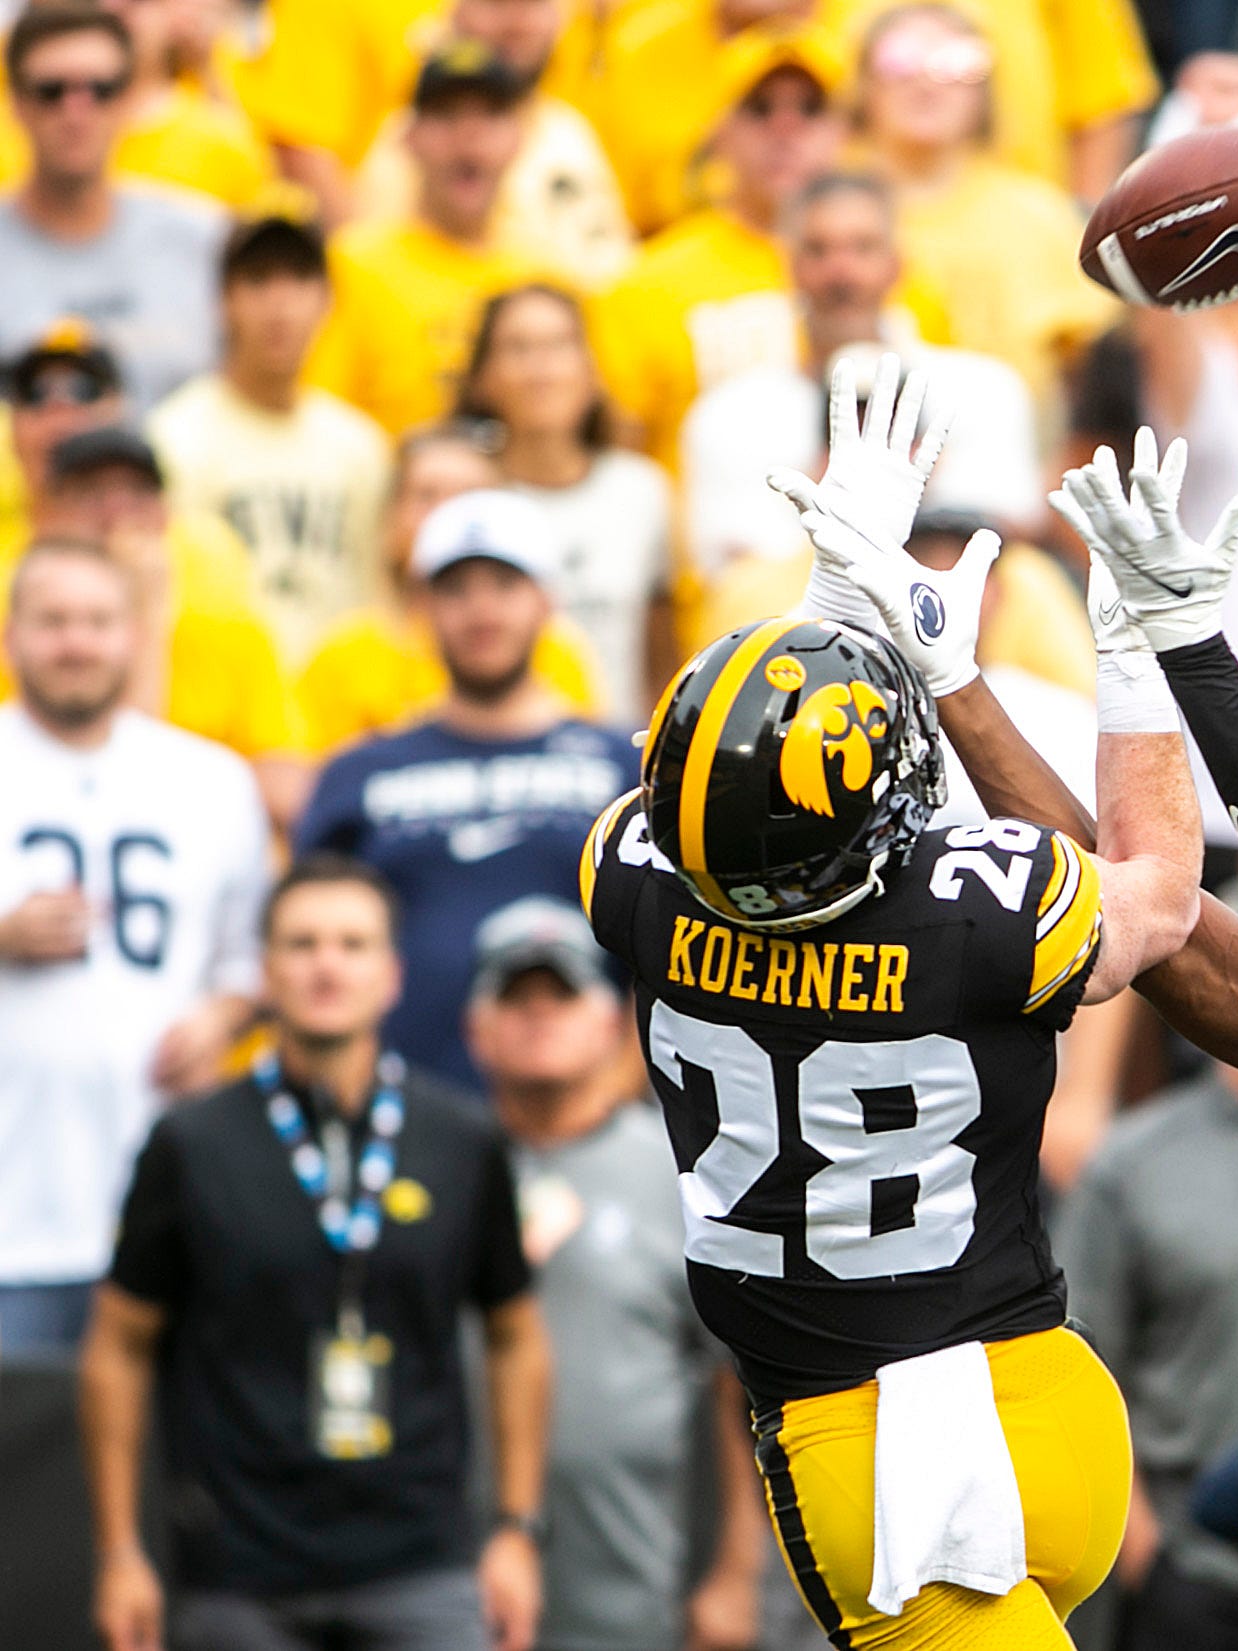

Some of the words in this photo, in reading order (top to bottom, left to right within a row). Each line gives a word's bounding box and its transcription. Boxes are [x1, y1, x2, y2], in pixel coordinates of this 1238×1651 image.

[929, 817, 1042, 912] 28
[667, 915, 910, 1013] KOERNER
[649, 999, 982, 1281] 28
